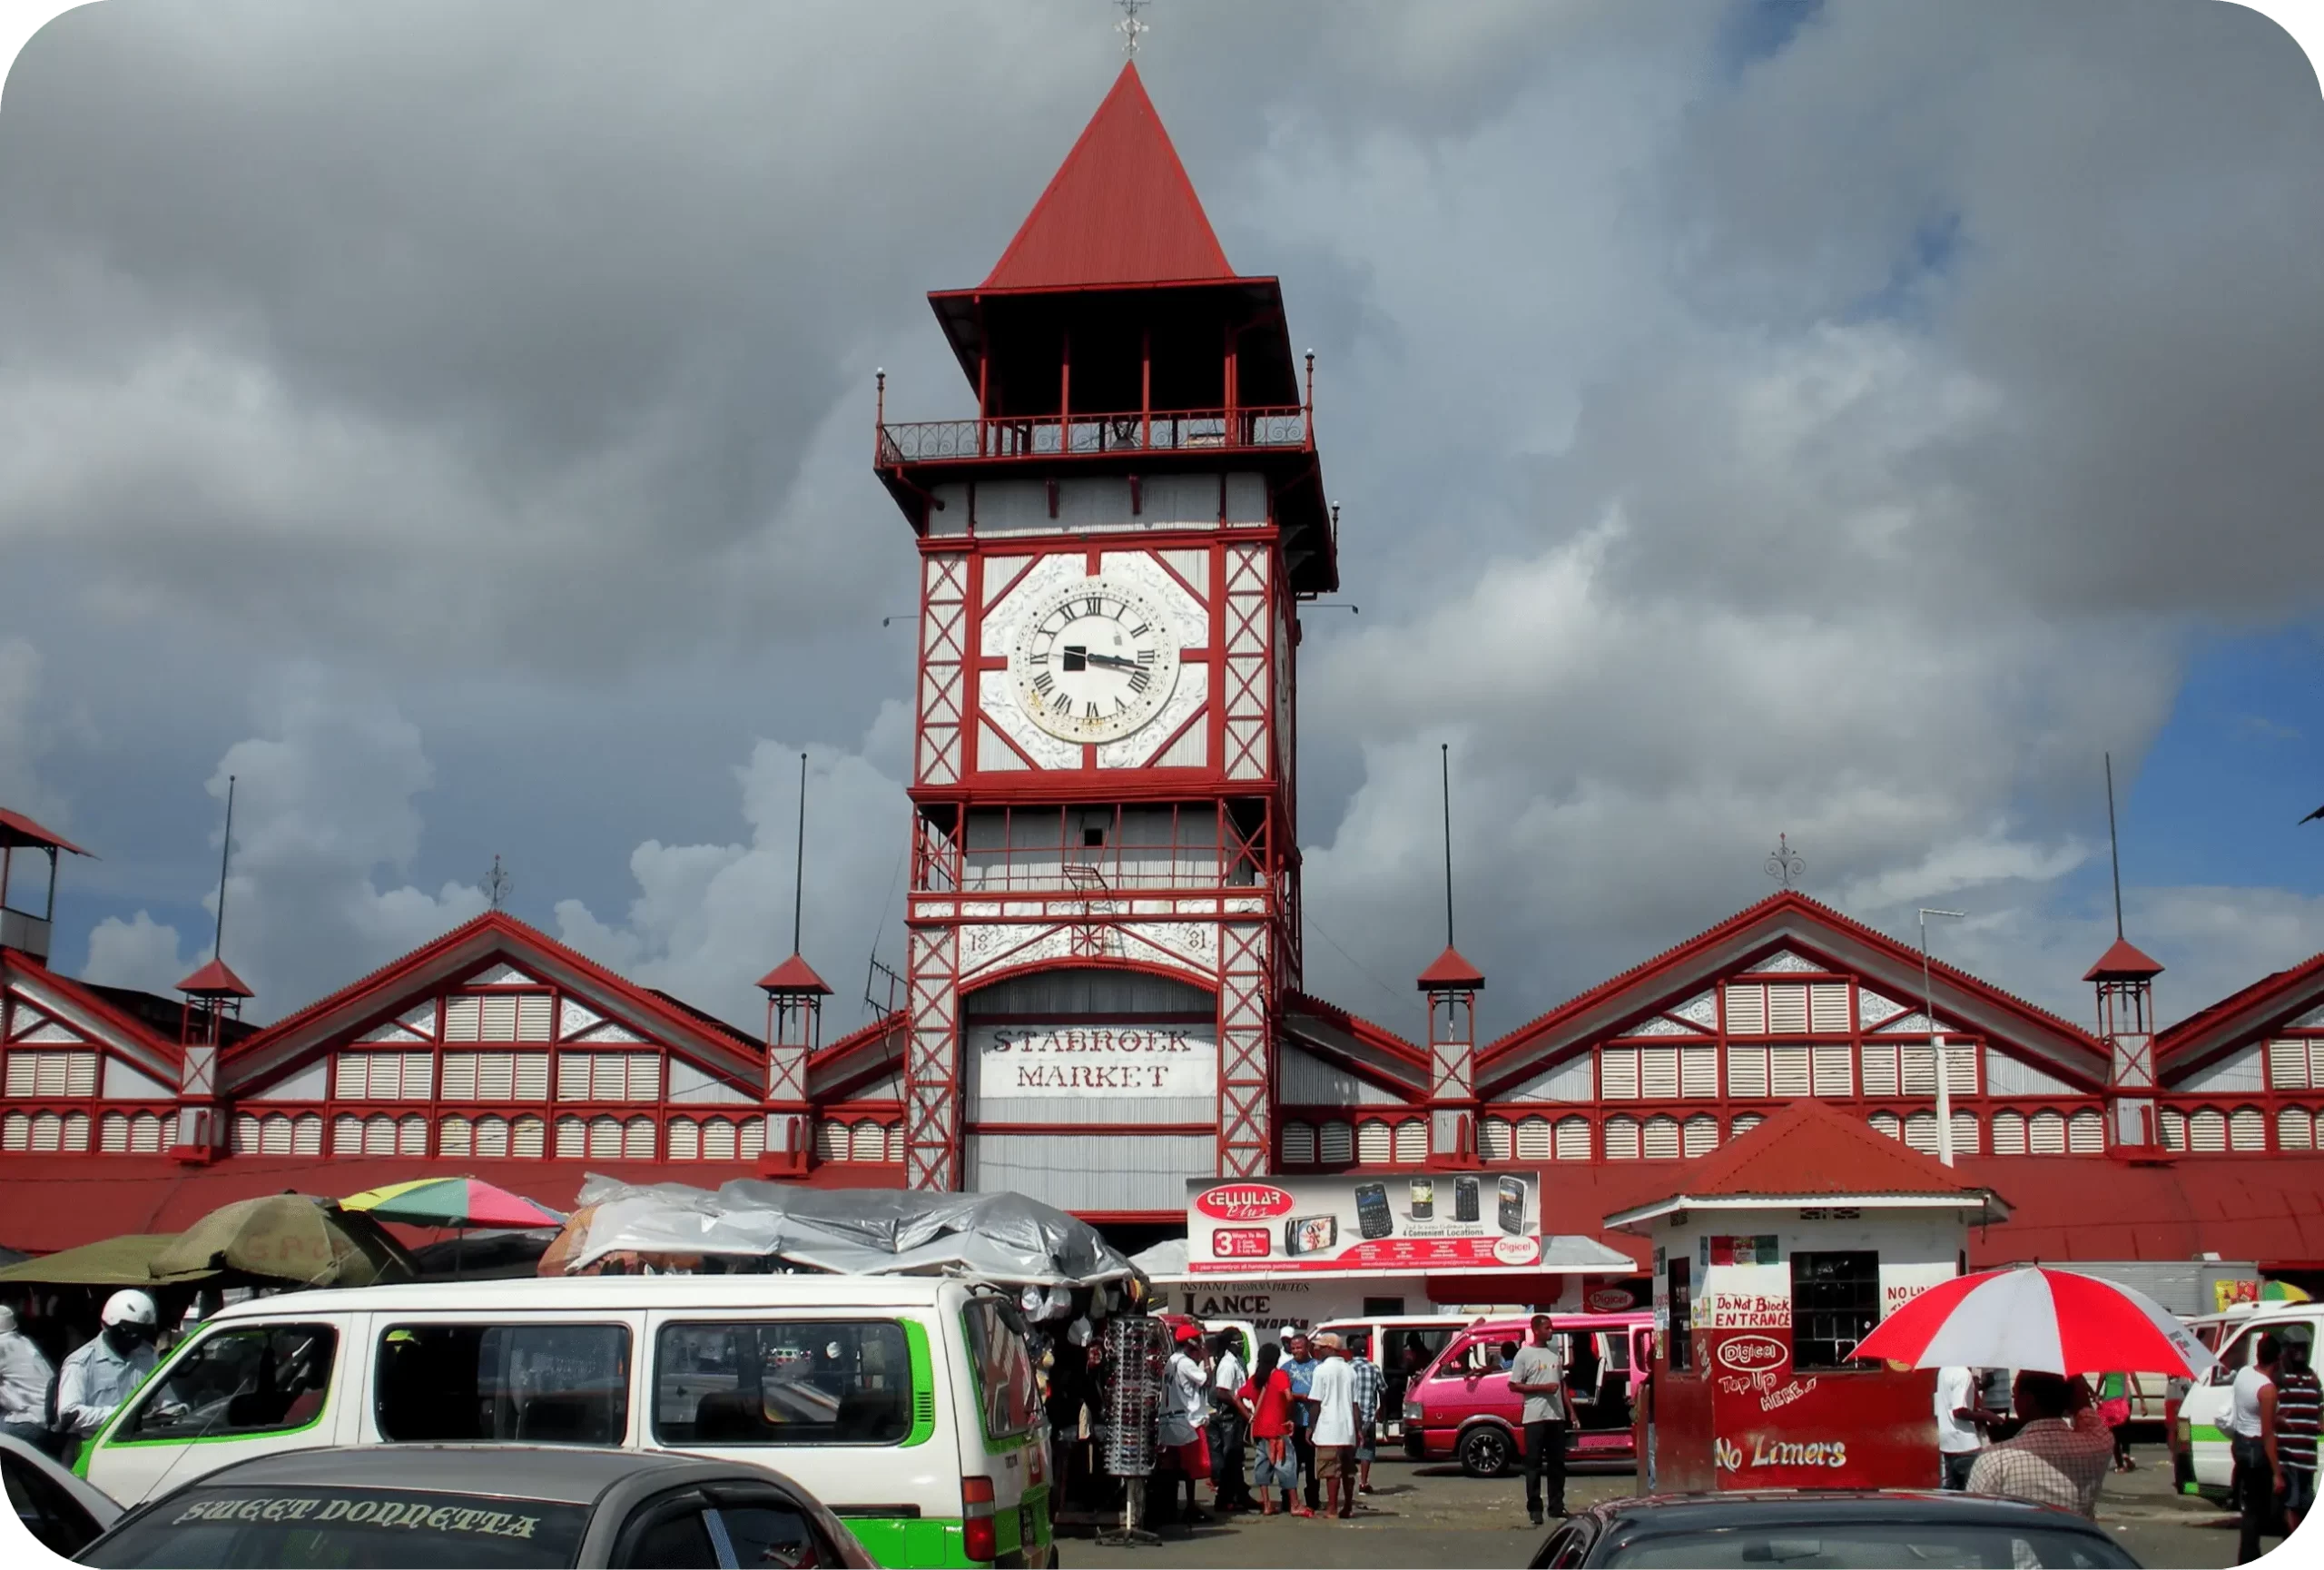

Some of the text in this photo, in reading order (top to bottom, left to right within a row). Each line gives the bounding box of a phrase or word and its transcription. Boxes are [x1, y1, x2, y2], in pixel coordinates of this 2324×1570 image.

[993, 1030, 1192, 1053] STABROEK
[1017, 1064, 1169, 1088] MARKET
[1206, 1191, 1281, 1206] CELLULAR
[1226, 1203, 1276, 1219] Plus
[1446, 1228, 1484, 1237] Locations
[1215, 1230, 1234, 1256] 3
[1499, 1241, 1531, 1253] Digicel
[1179, 1281, 1228, 1291] INSTANT
[1887, 1286, 1907, 1300] NO
[1183, 1292, 1271, 1318] LANCE
[1592, 1293, 1629, 1305] Digicel
[1717, 1297, 1790, 1312] Do Not Block
[1715, 1312, 1790, 1327] ENTRANCE
[1718, 1371, 1777, 1396] Top Up
[1759, 1380, 1805, 1412] HERE
[1713, 1434, 1847, 1473] No Limers
[172, 1497, 543, 1539] SWEET DONNETTA
